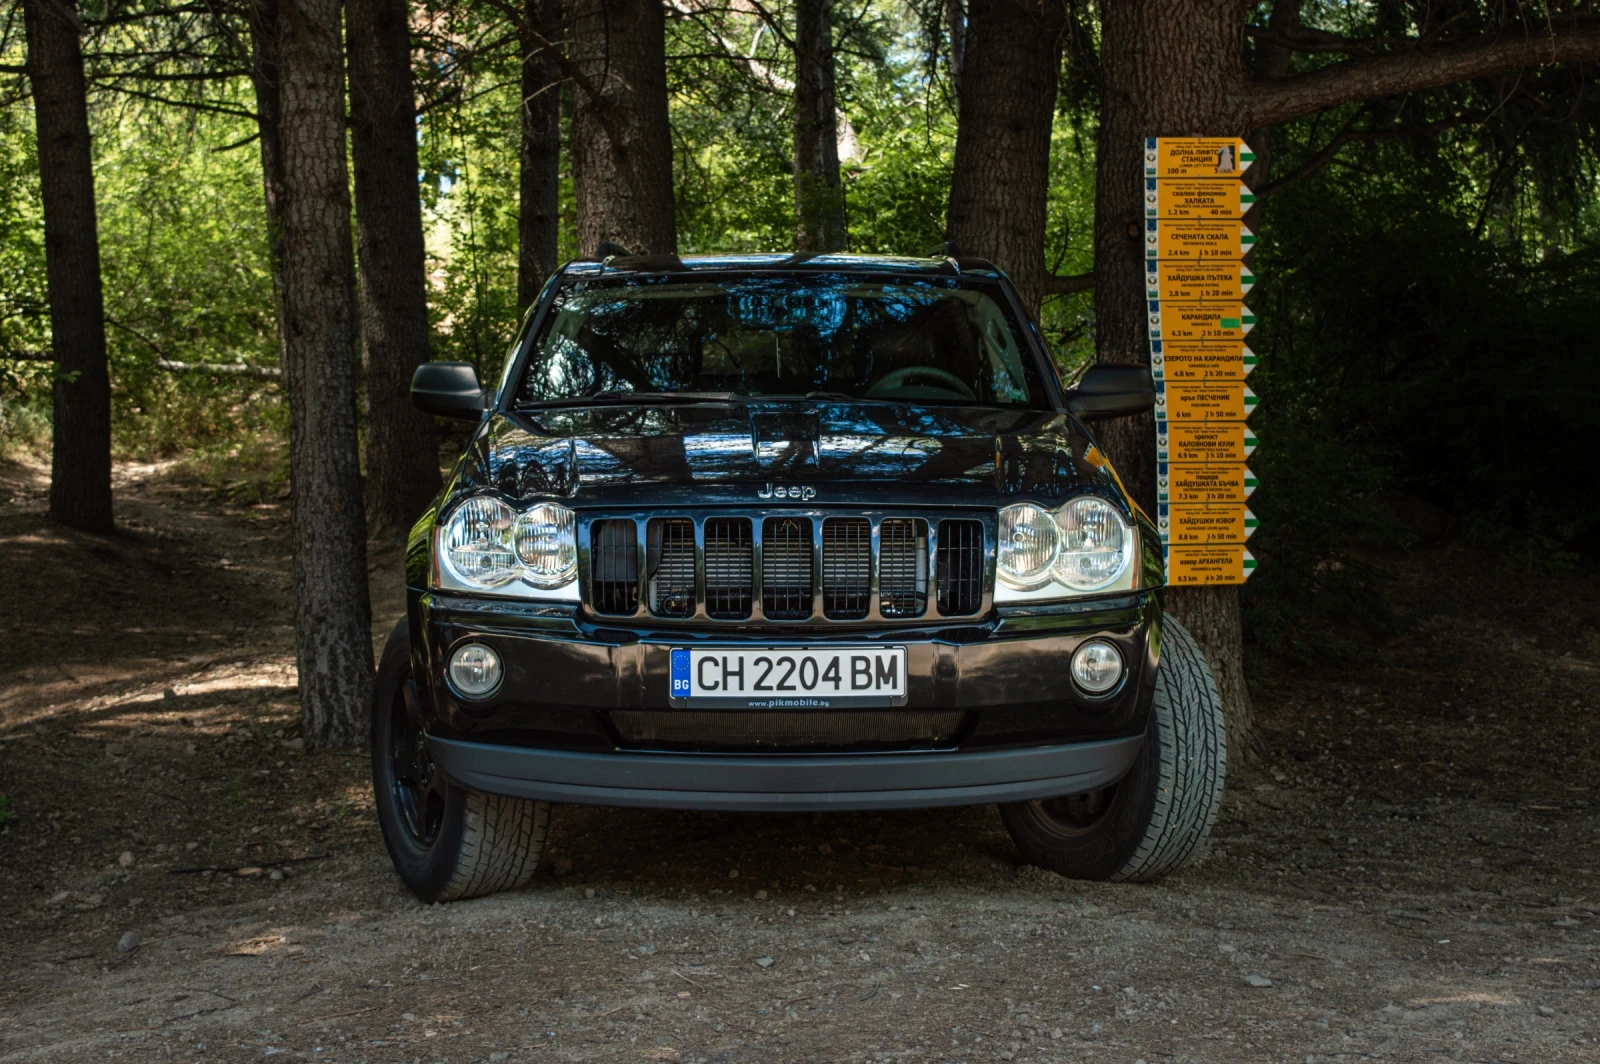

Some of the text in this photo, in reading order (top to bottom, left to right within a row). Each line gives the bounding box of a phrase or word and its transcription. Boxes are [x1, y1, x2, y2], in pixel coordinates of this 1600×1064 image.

[758, 482, 816, 501] Jeep
[698, 656, 897, 690] CH 2204 BM
[674, 680, 689, 690] BG
[748, 698, 830, 708] www.pikmobile.bg
